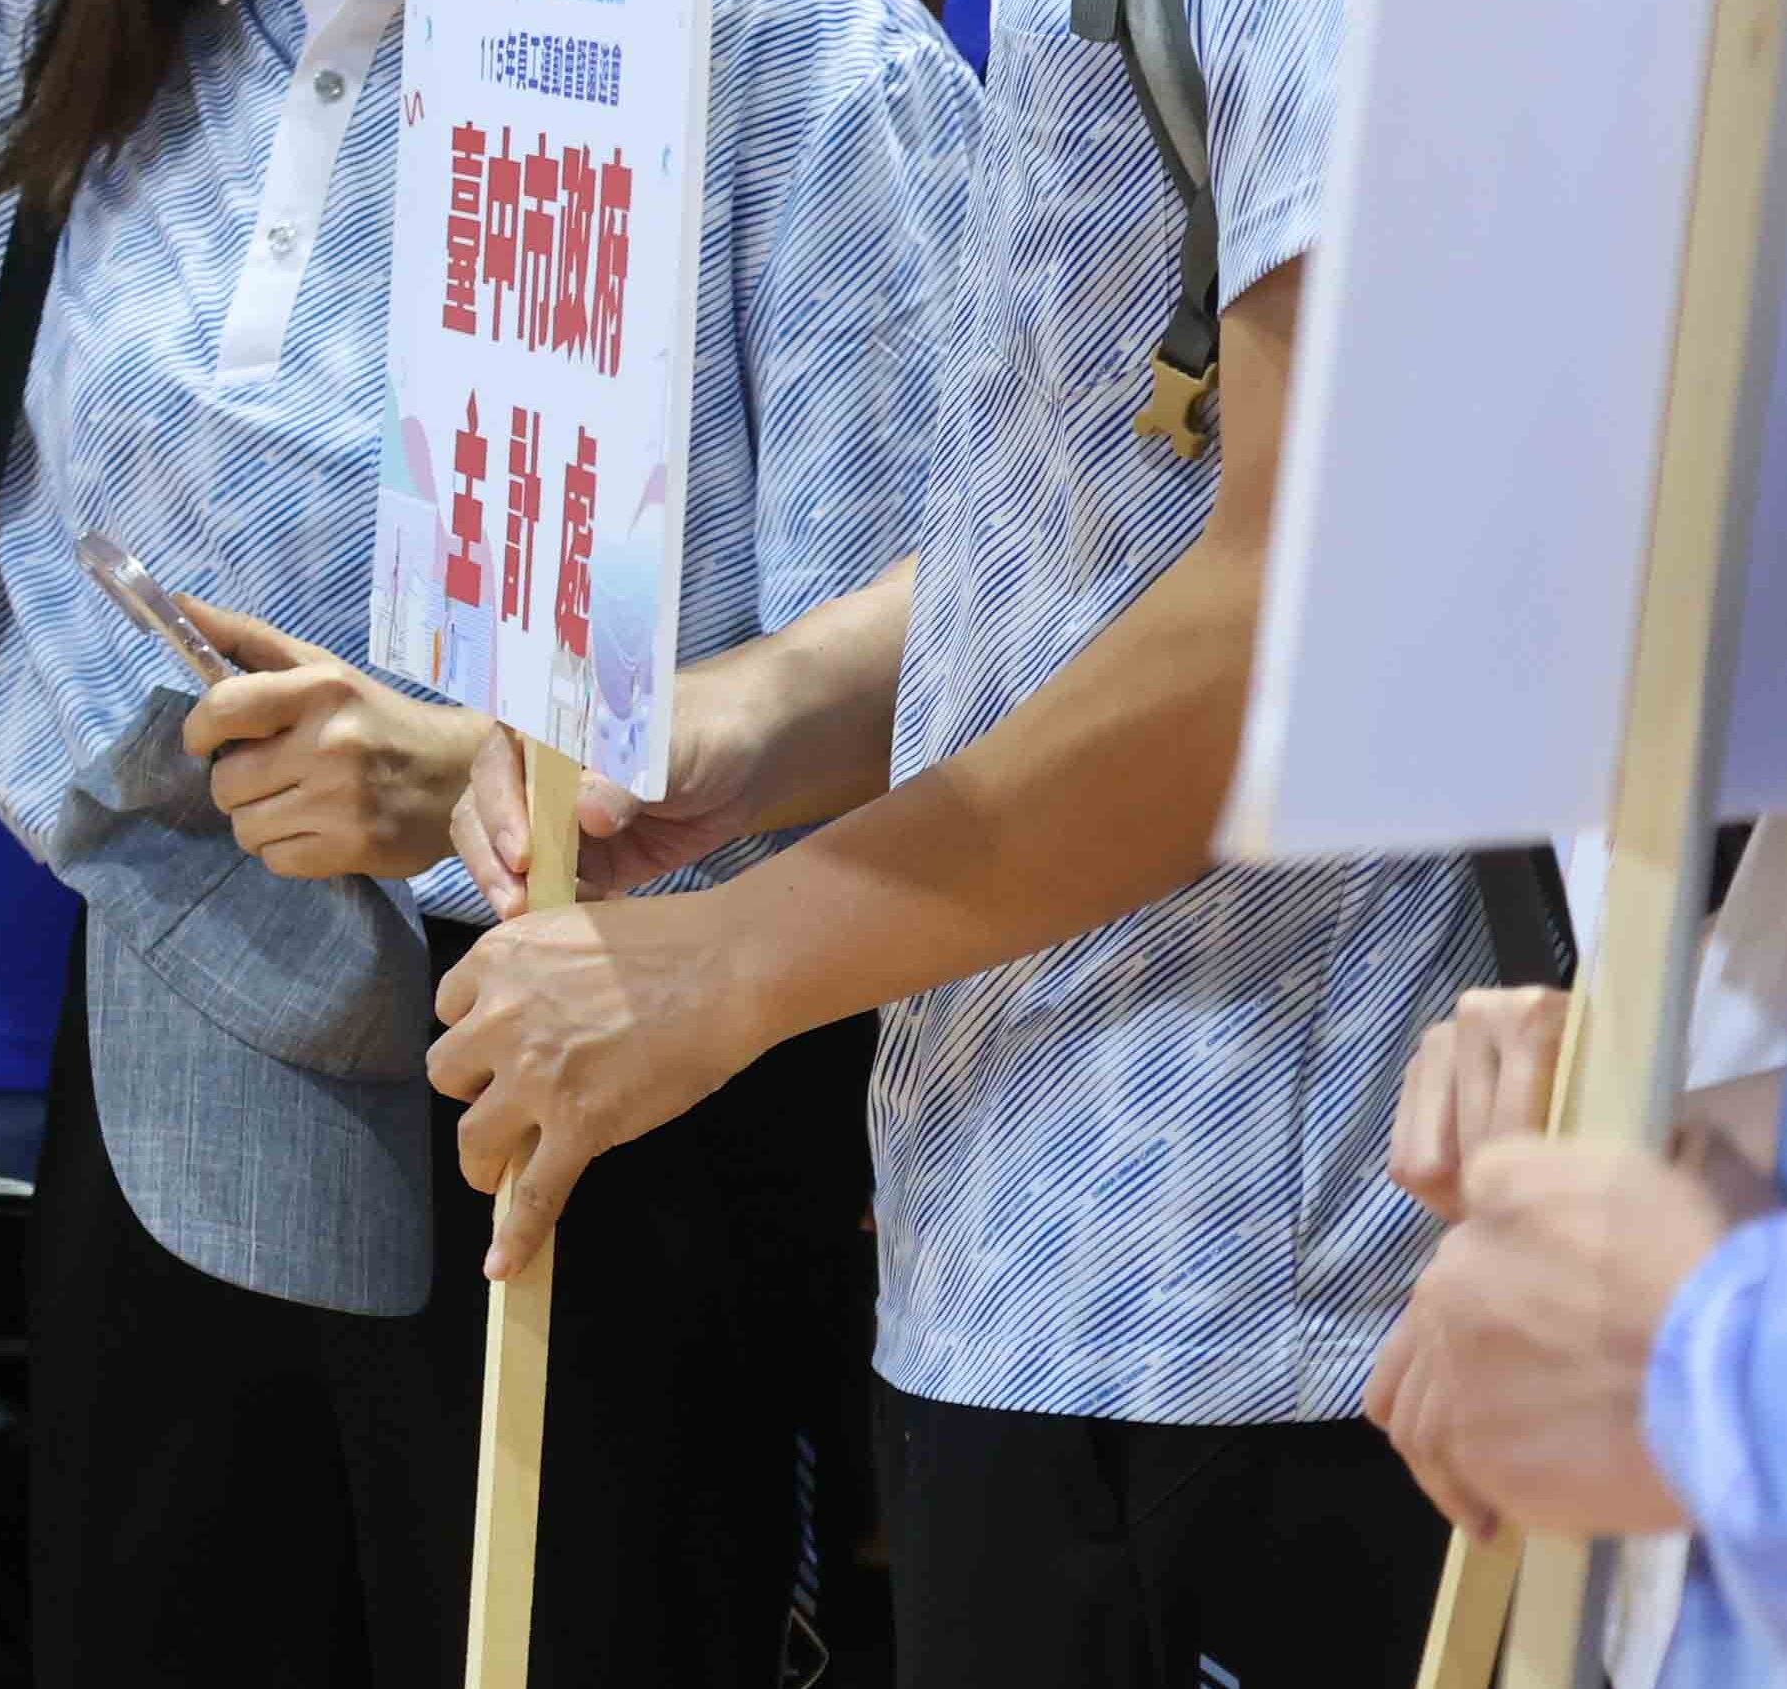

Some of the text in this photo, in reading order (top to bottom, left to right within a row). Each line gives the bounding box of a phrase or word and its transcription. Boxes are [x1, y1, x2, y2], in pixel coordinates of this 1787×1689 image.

[442, 120, 633, 379] 臺中市政府
[445, 387, 598, 659] 主計處
